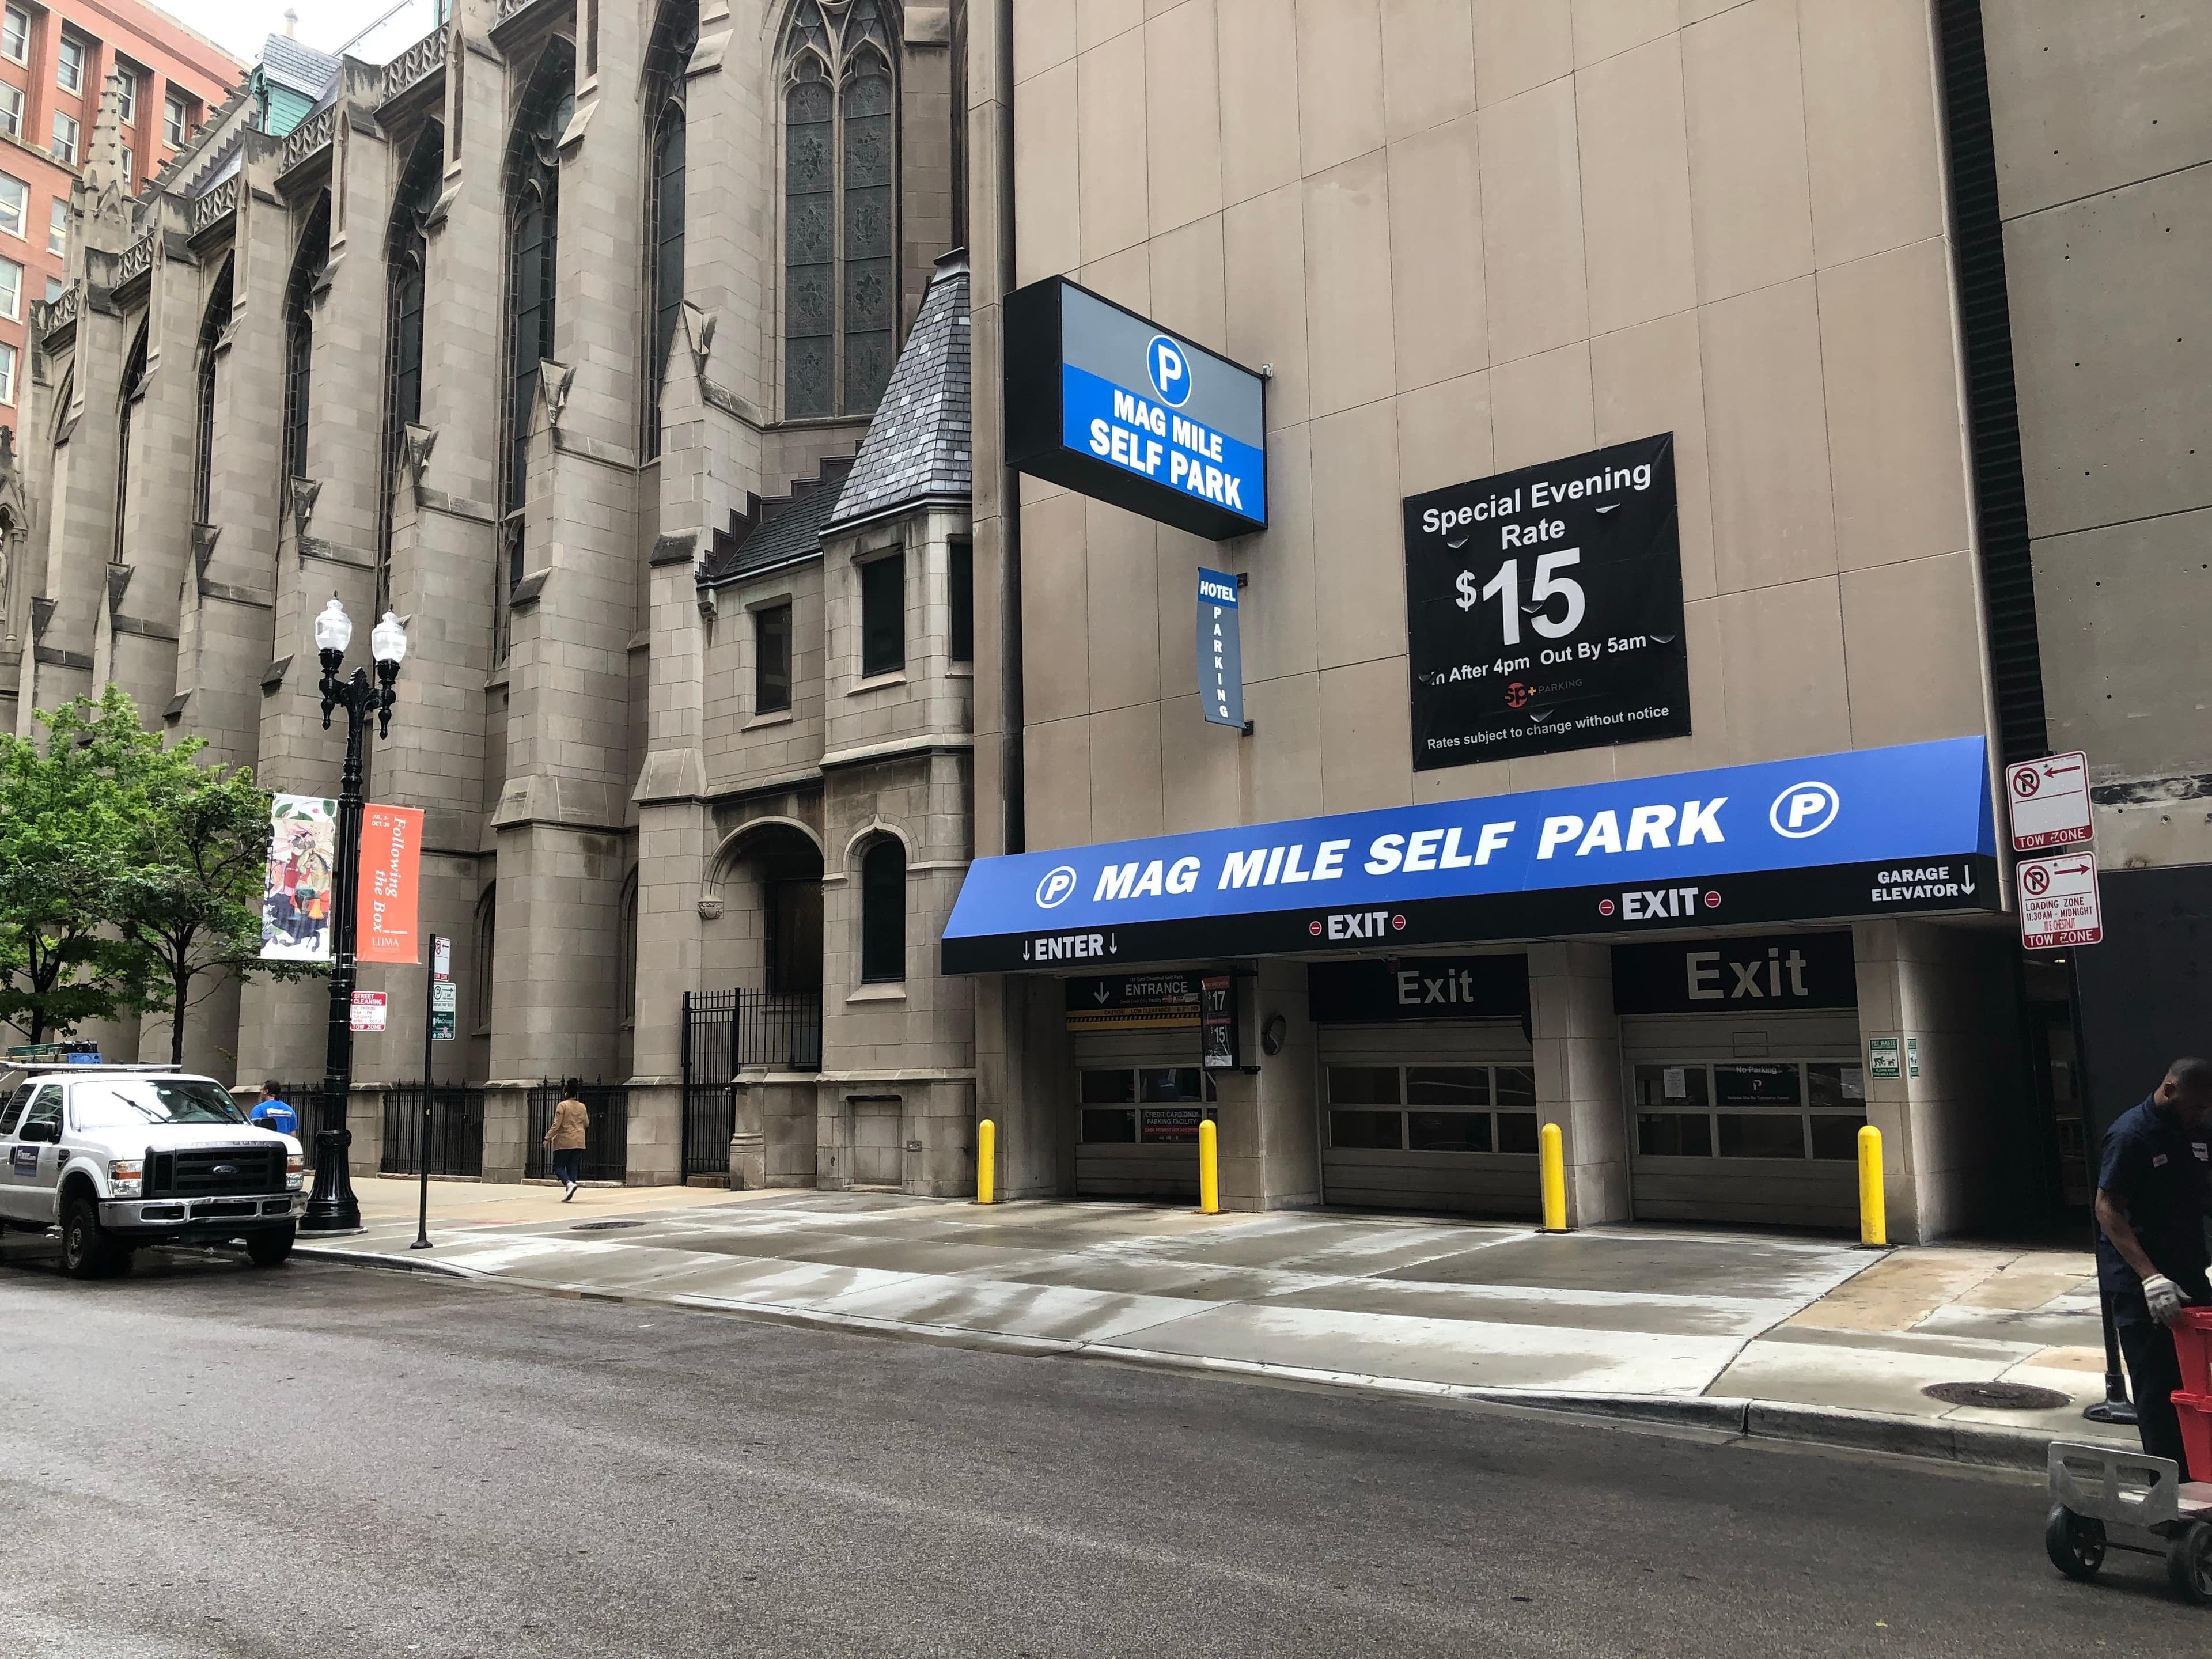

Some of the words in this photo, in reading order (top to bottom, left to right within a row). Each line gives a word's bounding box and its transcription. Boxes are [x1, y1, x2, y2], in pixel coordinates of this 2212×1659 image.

[1158, 344, 1182, 392] P
[1113, 389, 1166, 438] MAG
[1173, 415, 1223, 463] MILE
[1089, 418, 1163, 475] SELF
[1170, 449, 1243, 510] PARK
[1422, 488, 1521, 535] Special
[1531, 463, 1652, 507] Evening
[1501, 518, 1566, 550] Rate
[1200, 580, 1236, 602] HOTEL
[1213, 606, 1228, 718] PARKING
[1449, 664, 1488, 683] After
[1493, 655, 1530, 676] 4pm
[1540, 649, 1573, 665] Out
[1578, 641, 1601, 660] By
[1607, 635, 1647, 653] 5am
[1538, 678, 1583, 694] PARKING
[1427, 736, 1460, 750] Rates
[1463, 728, 1508, 745] subject
[1510, 727, 1522, 738] to
[1526, 721, 1572, 735] change
[1575, 712, 1624, 729] without
[1627, 706, 1669, 722] notice
[1043, 875, 1069, 901] P
[1092, 855, 1200, 902] MAG
[1217, 839, 1351, 891] MILE
[1363, 821, 1516, 875] SELF
[1536, 797, 1729, 860] PARK
[1787, 793, 1827, 828] P
[2018, 834, 2044, 848] TOW
[2051, 828, 2086, 843] ZONE
[385, 816, 406, 899] Following
[374, 869, 388, 896] the
[1877, 866, 1950, 884] GARAGE
[1622, 887, 1699, 921] EXIT
[1871, 883, 1959, 902] ELEVATOR
[2025, 900, 2059, 911] LOADING
[2064, 897, 2084, 907] ZONE
[373, 900, 385, 933] Box
[1327, 911, 1389, 941] EXIT
[2027, 911, 2052, 921] 11:30AM
[2060, 906, 2092, 918] MIDNIGHT
[2049, 921, 2052, 931] E
[2053, 918, 2075, 930] CHESTNUT
[372, 937, 399, 947] LUMA
[1035, 934, 1104, 961] ENTER
[2028, 933, 2054, 946] TOW
[2059, 929, 2094, 944] ZONE
[1397, 969, 1474, 1005] Exit
[1686, 948, 1809, 1000] Exit
[1125, 981, 1188, 996] ENTRANCE
[1207, 990, 1226, 1010] $17
[1210, 1027, 1225, 1043] $15
[1748, 1066, 1777, 1074] Parking
